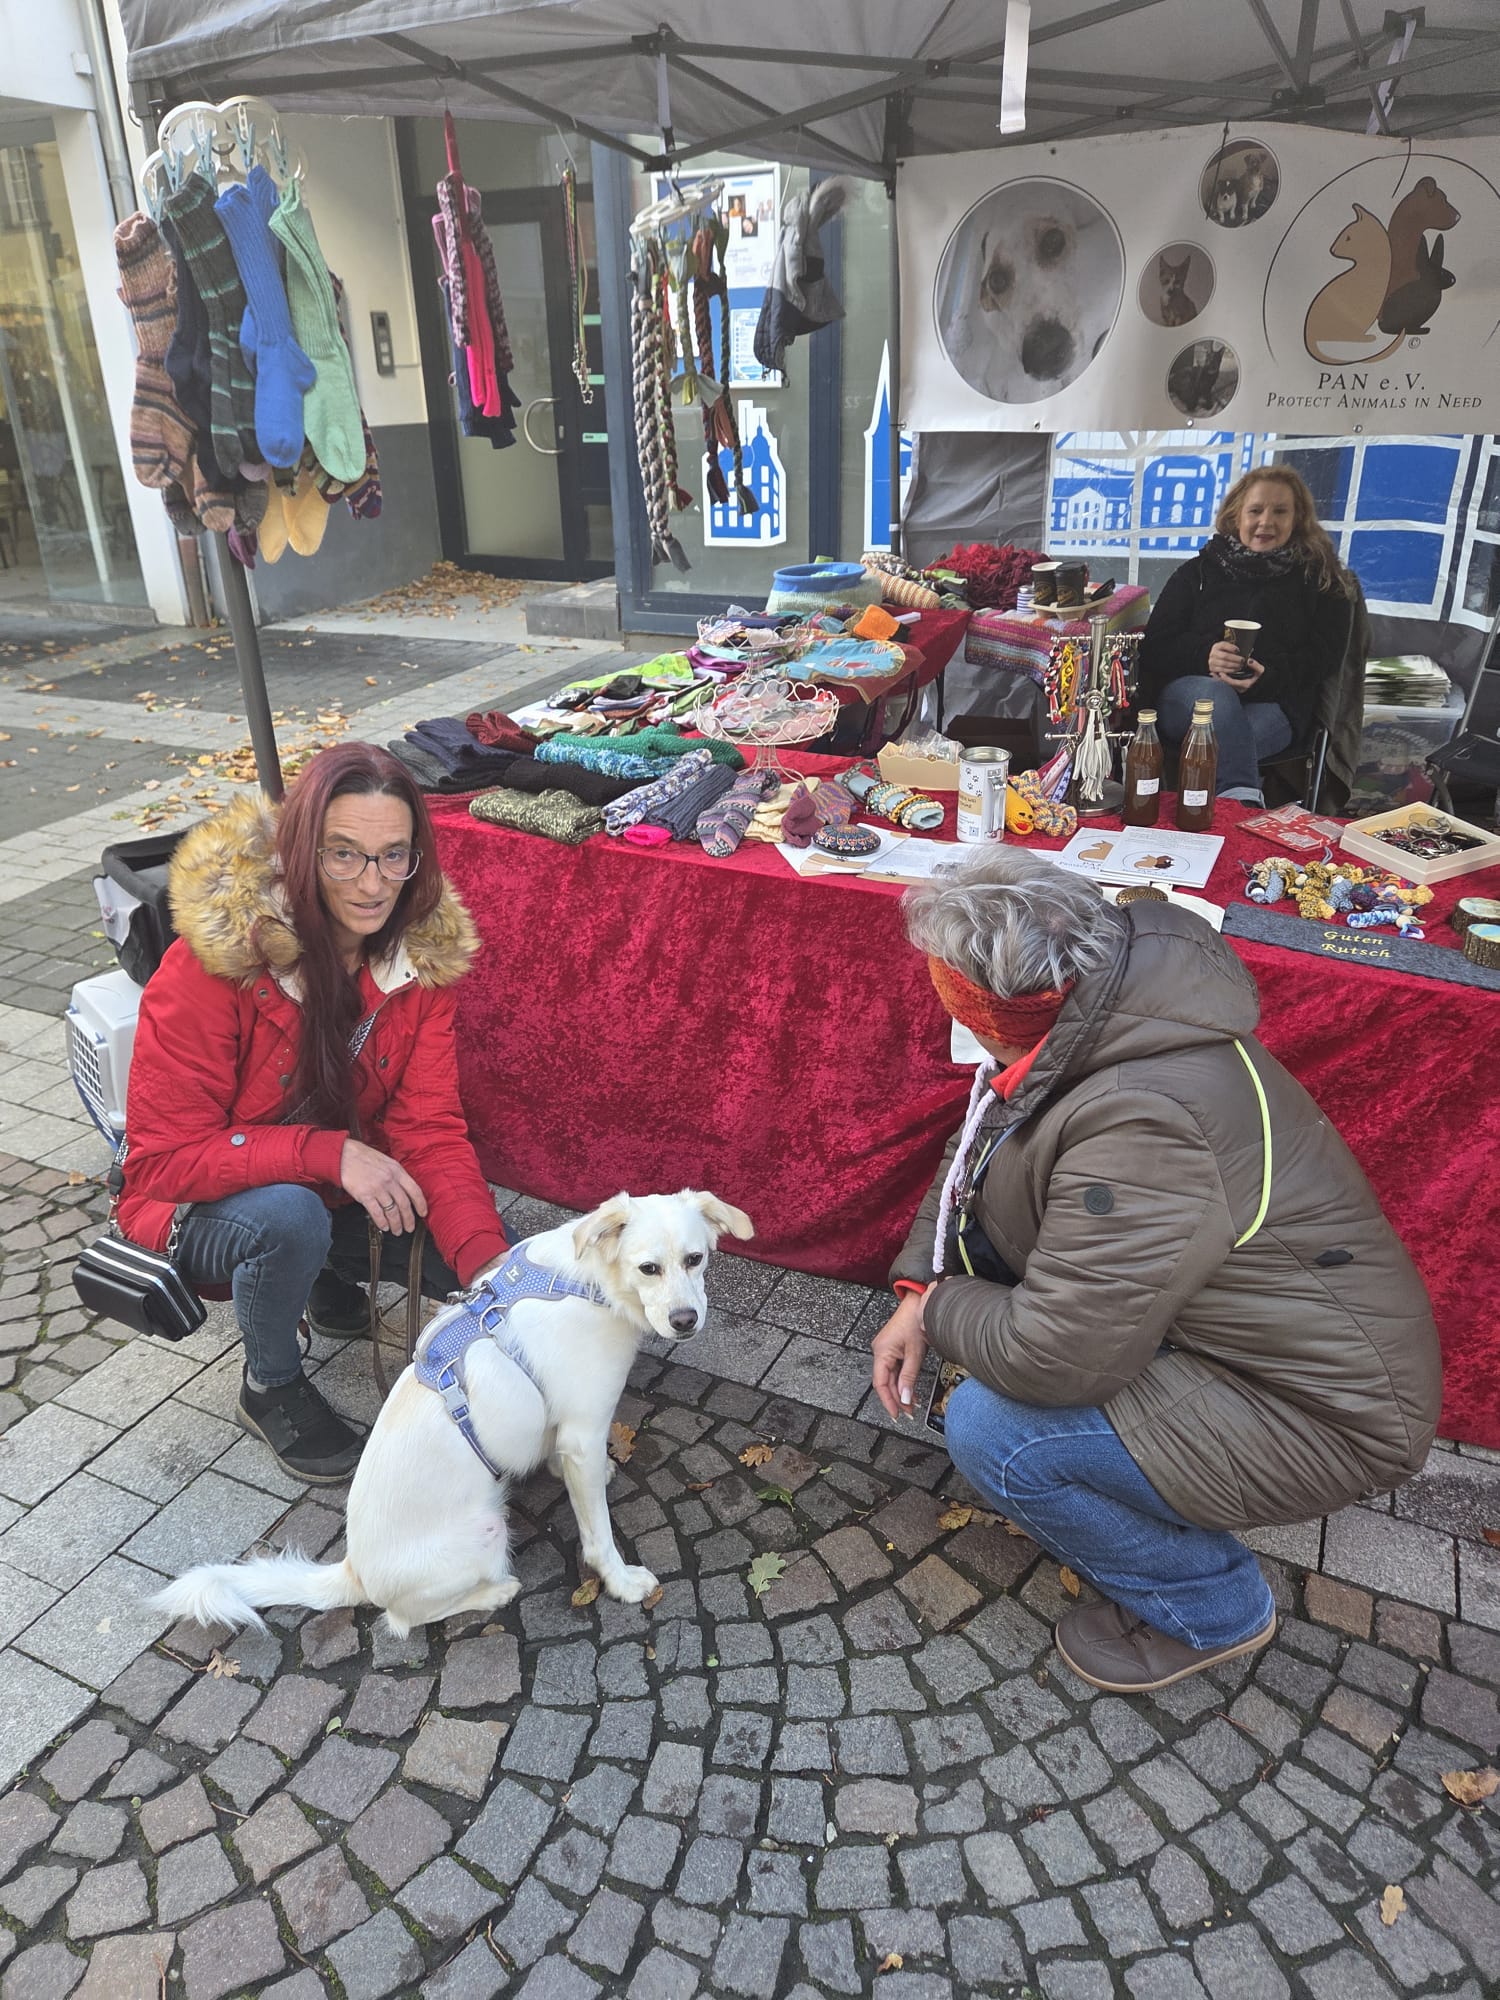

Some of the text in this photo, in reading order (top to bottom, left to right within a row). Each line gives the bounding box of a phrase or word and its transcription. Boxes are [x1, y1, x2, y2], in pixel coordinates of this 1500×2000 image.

[1317, 372, 1369, 390] PAN
[1323, 931, 1384, 945] Guten
[1321, 943, 1393, 958] Rutsch
